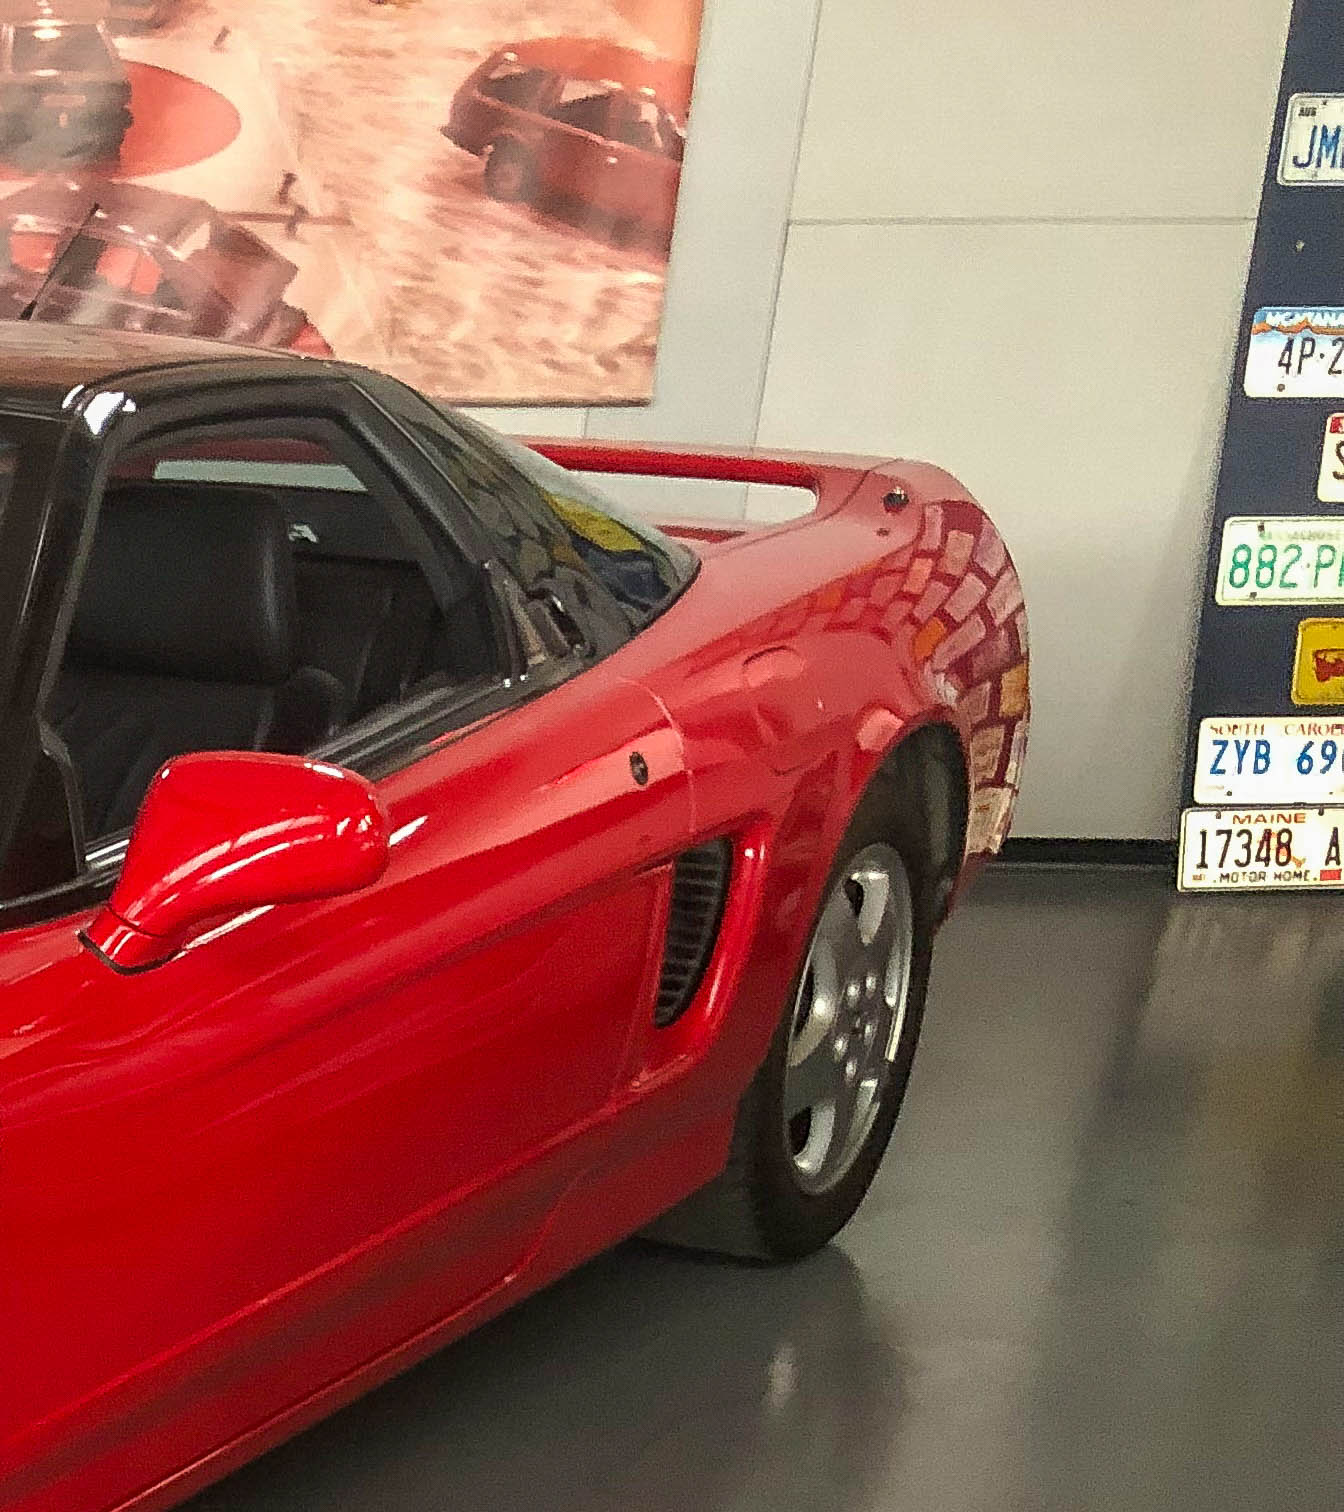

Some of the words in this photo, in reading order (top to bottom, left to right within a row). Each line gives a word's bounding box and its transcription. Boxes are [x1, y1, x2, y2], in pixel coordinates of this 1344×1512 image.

[1292, 124, 1344, 169] JM
[1209, 739, 1271, 775] ZYB
[1296, 739, 1344, 775] 69
[1233, 813, 1306, 824] MAINE
[1196, 828, 1293, 869] 17348
